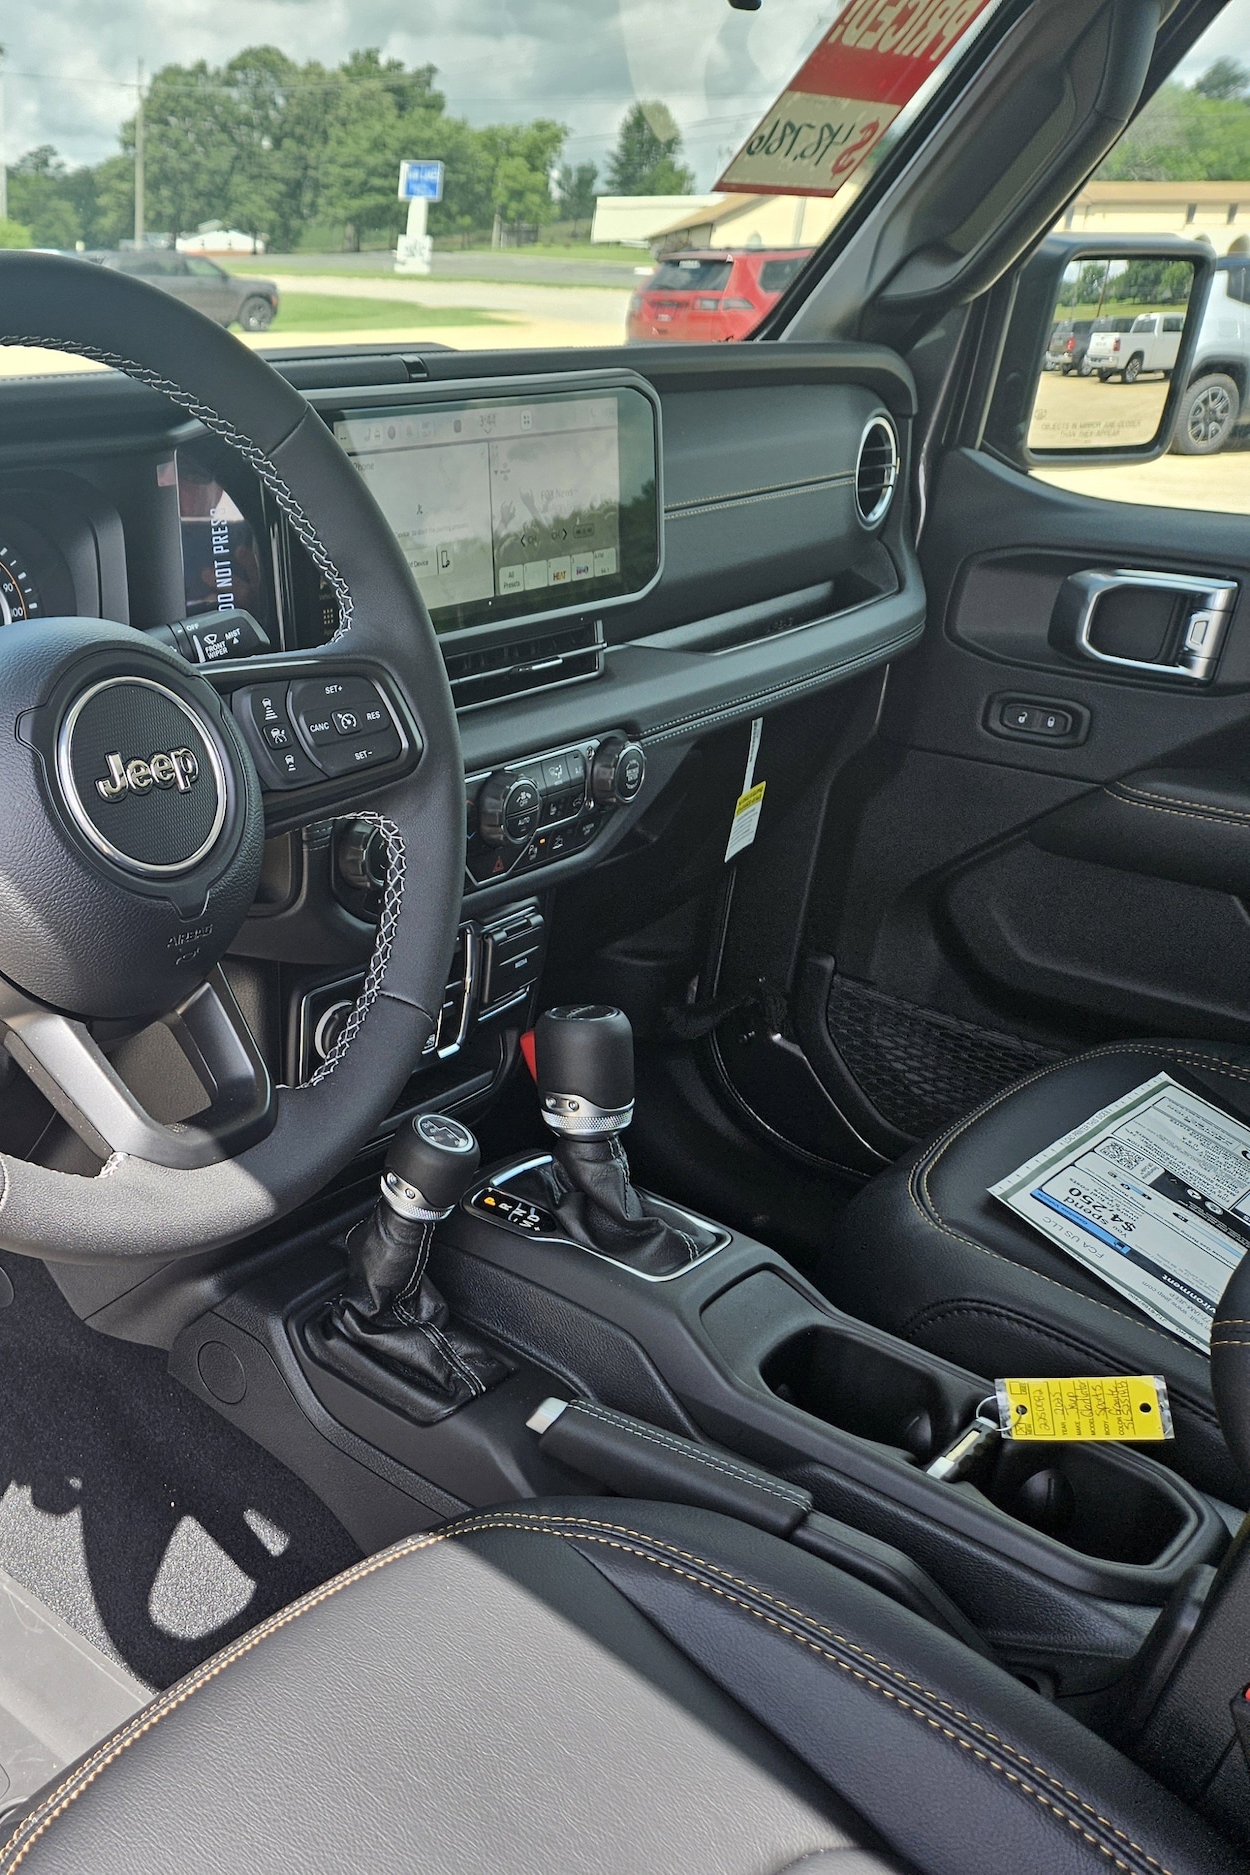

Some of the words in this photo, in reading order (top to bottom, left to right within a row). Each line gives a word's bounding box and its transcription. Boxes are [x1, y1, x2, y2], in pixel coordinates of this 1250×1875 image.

[210, 508, 230, 554] PRESS
[214, 560, 233, 588] NOT
[553, 571, 567, 581] HEAT
[2, 582, 14, 593] 90
[186, 623, 200, 631] OFF
[225, 628, 241, 640] MIST
[205, 640, 226, 653] FRONT
[207, 647, 228, 659] WIPER
[325, 685, 343, 695] SET+
[366, 711, 381, 721] RES
[310, 721, 329, 732] CANC
[95, 747, 199, 803] Jeep
[518, 816, 530, 826] AUTO
[484, 1197, 496, 1206] P
[498, 1203, 513, 1211] R
[1062, 1194, 1110, 1228] spend
[1066, 1183, 1138, 1234] $4,250
[527, 1214, 540, 1222] D
[1041, 1215, 1064, 1231] LLC
[1063, 1229, 1081, 1242] US
[1079, 1240, 1105, 1259] FCA
[1160, 1272, 1218, 1314] vironment
